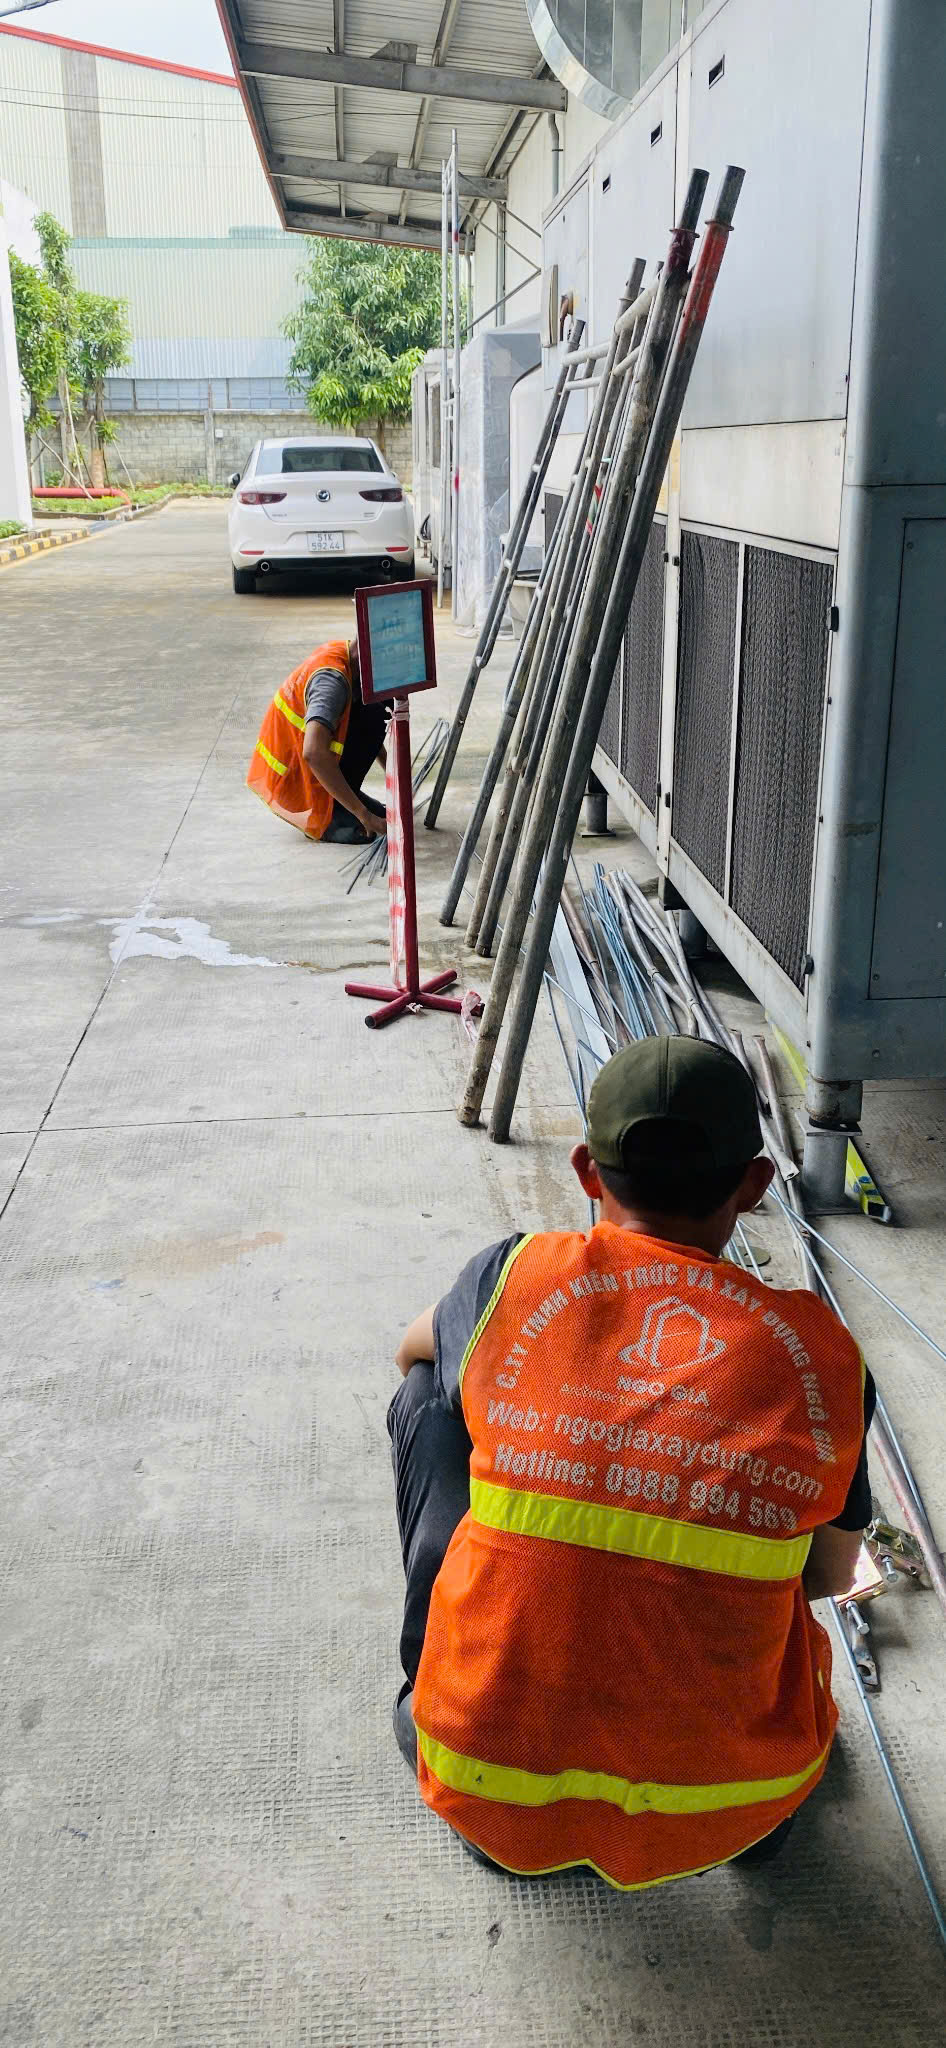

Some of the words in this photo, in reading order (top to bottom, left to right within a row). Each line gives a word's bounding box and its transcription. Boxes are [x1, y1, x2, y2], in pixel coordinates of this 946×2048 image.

[520, 1288, 569, 1339] TNHH
[623, 1260, 679, 1291] TRÚC
[671, 1384, 710, 1408] GIA
[487, 1399, 548, 1432] Web:
[554, 1414, 825, 1500] ngogiaxaydung.com
[495, 1443, 597, 1488] Hotline:
[605, 1463, 680, 1503] 0988
[688, 1480, 741, 1520] 994
[748, 1496, 798, 1532] 569
